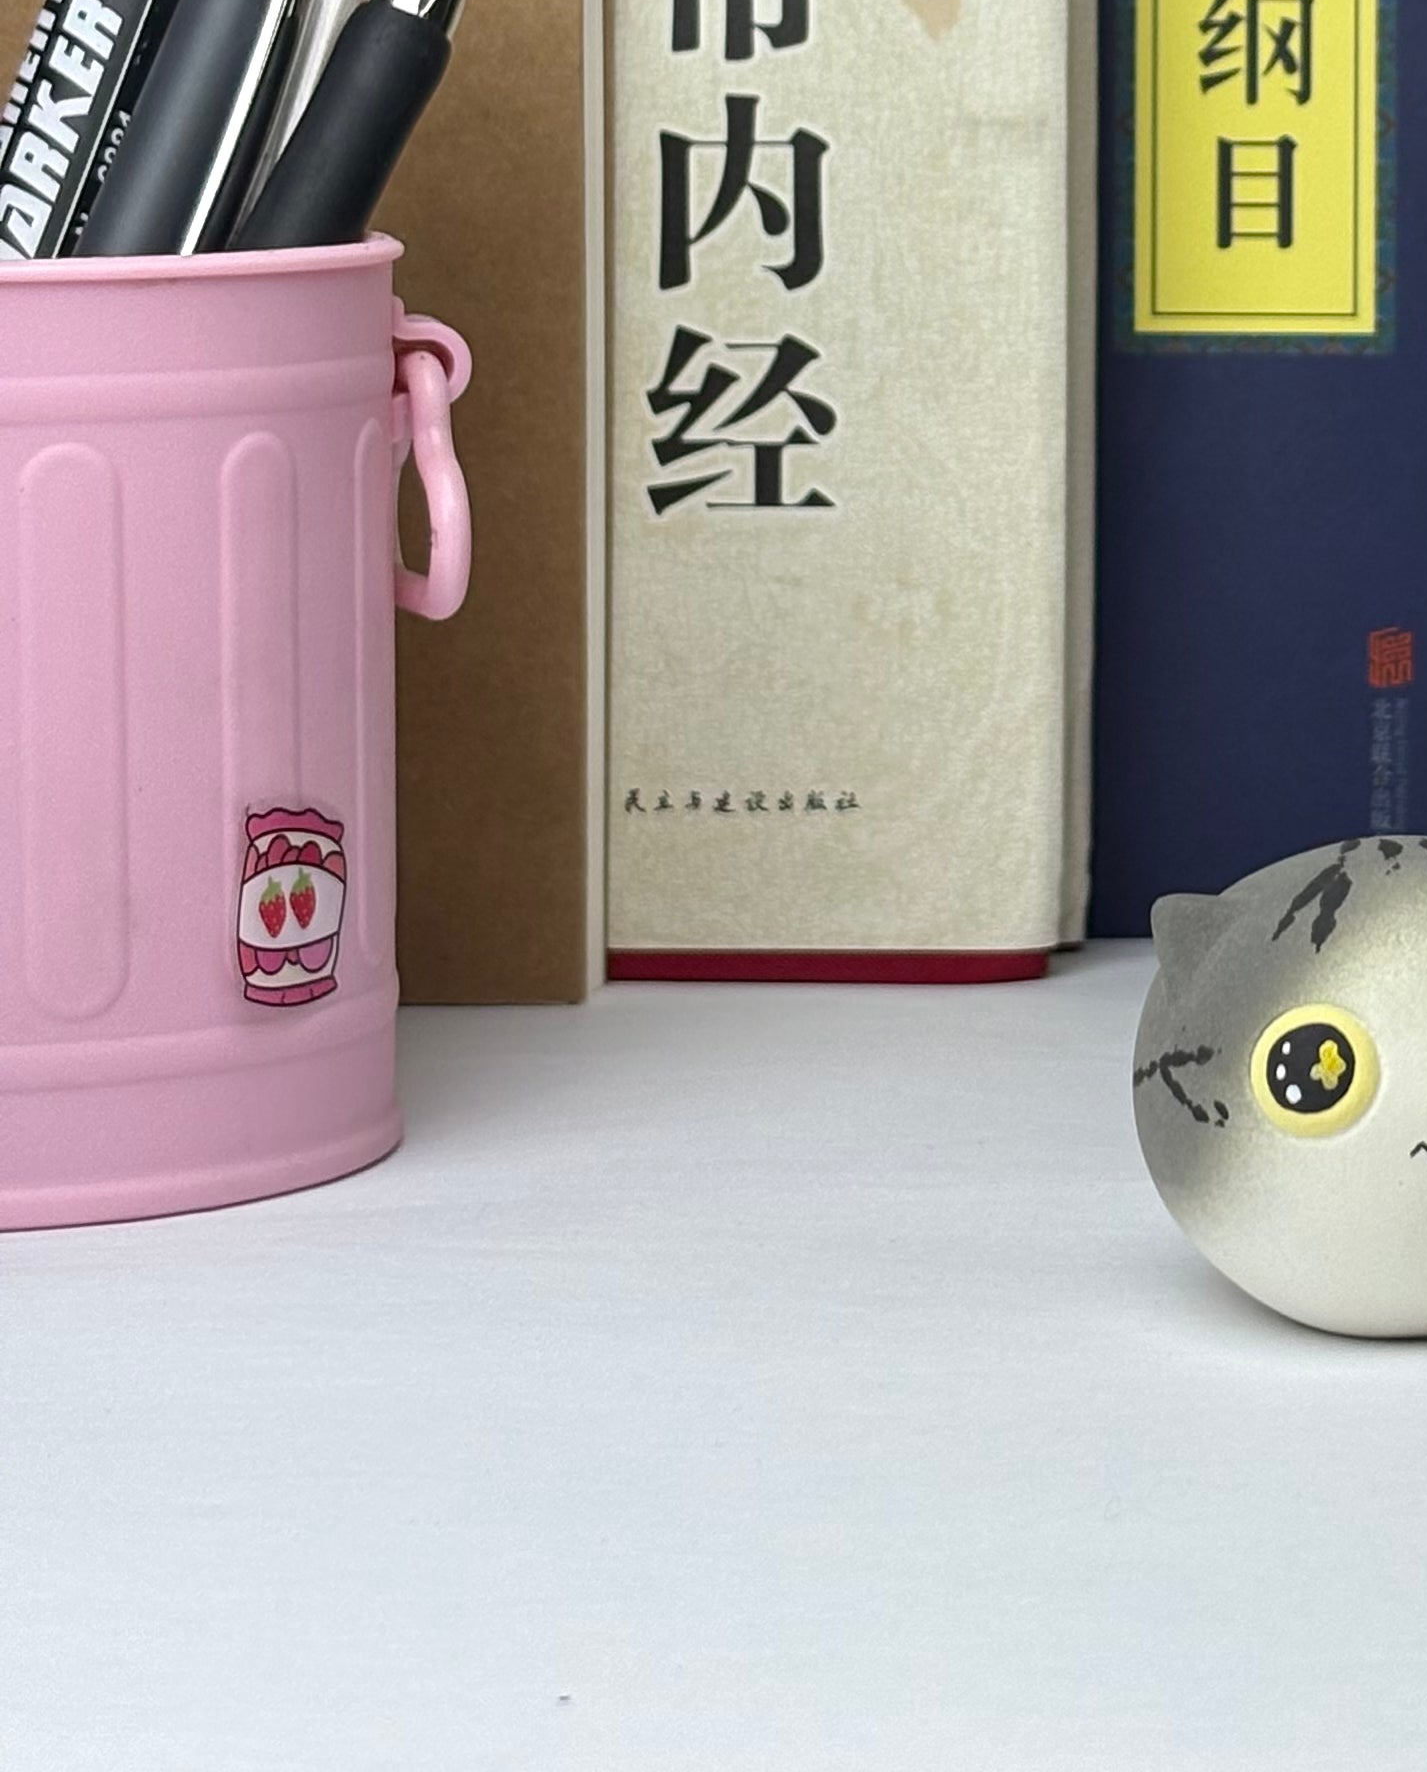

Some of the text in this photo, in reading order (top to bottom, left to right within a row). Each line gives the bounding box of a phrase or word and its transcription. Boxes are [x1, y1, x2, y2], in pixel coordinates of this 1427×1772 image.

[624, 787, 862, 813] 民主与建设出版社
